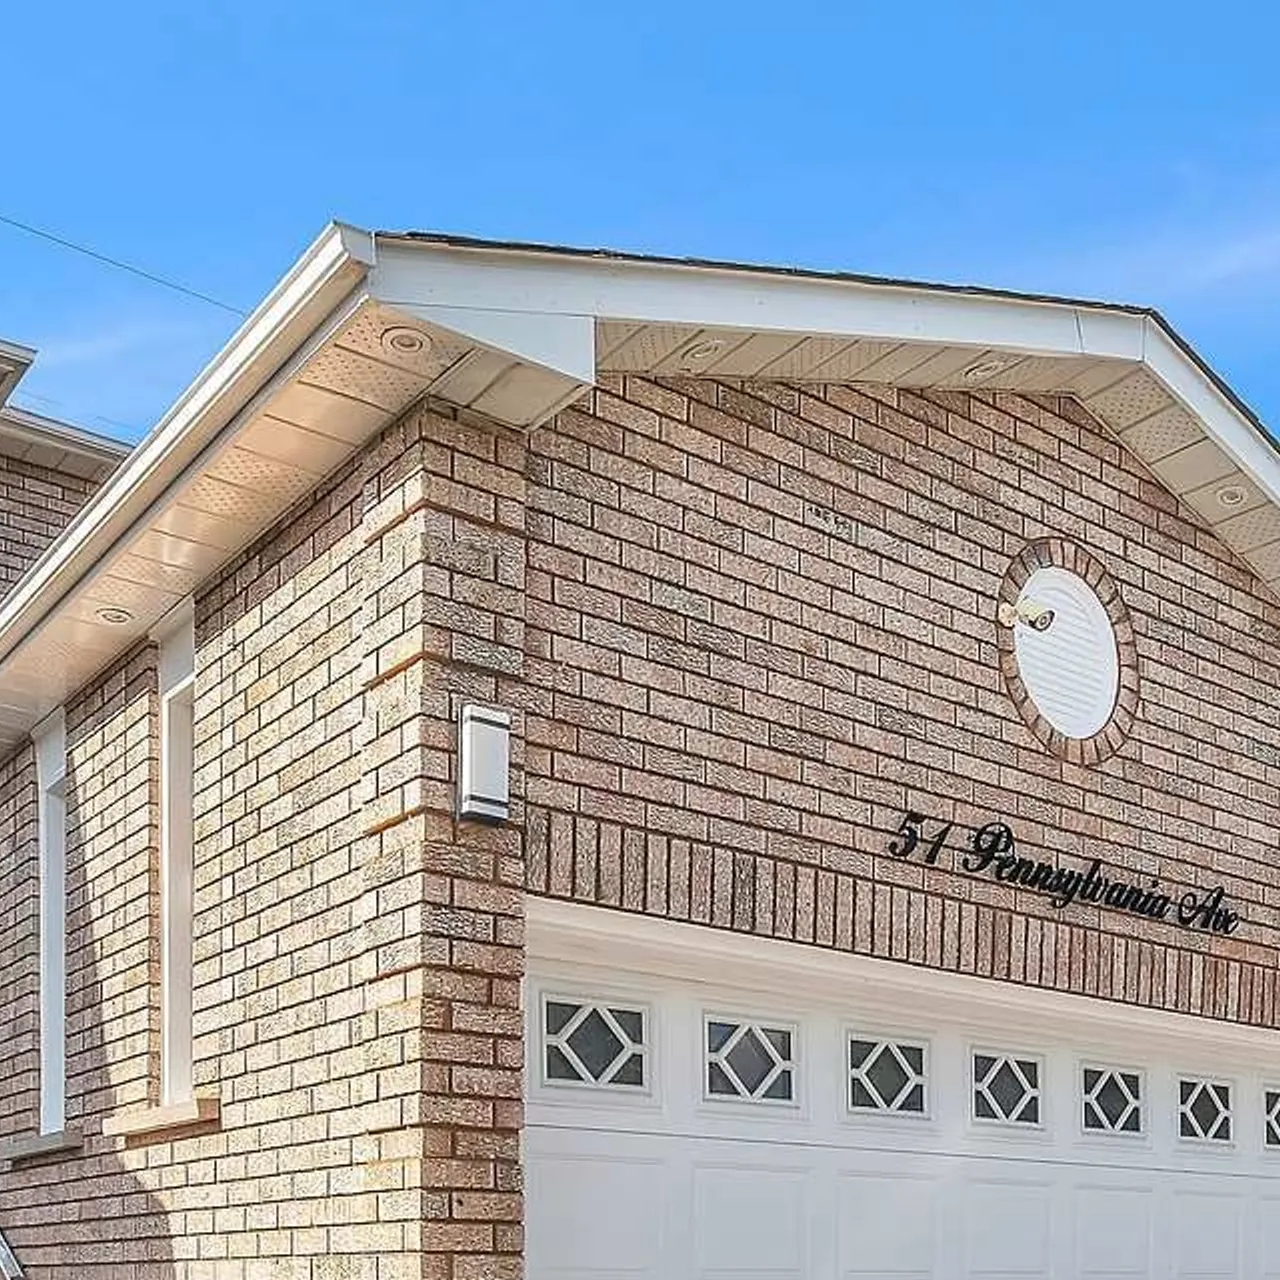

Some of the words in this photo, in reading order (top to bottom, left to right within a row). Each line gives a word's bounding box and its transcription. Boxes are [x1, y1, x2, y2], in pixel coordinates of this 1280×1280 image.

[889, 811, 954, 865] 51
[963, 822, 1170, 919] Pennsylvania
[1177, 885, 1240, 935] Ave
